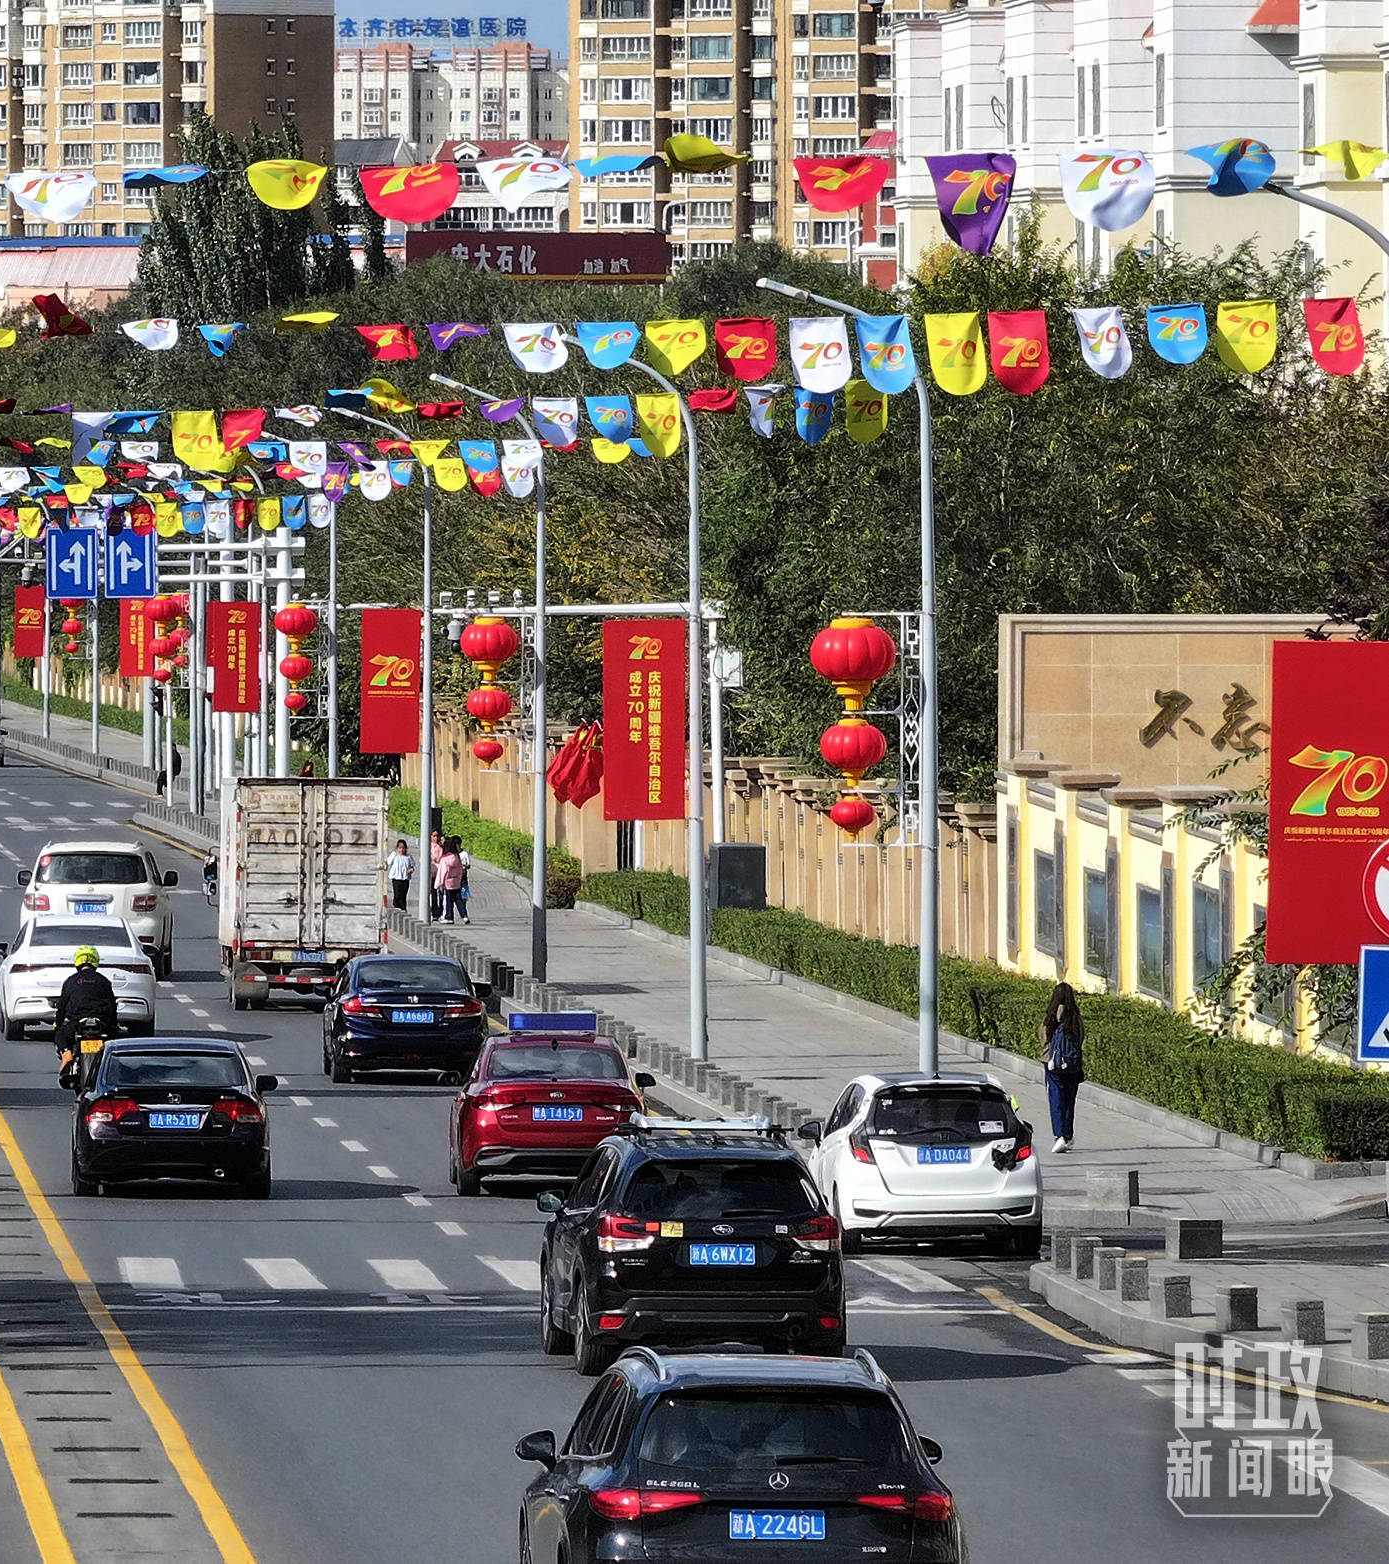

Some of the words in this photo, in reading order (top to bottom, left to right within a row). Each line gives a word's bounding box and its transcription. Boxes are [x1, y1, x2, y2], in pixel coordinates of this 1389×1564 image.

[374, 162, 442, 196] 70
[493, 161, 559, 190] 70
[1071, 154, 1141, 192] 70
[1084, 326, 1121, 354] 70
[1155, 315, 1199, 340] 70
[1227, 314, 1269, 343] 70
[1315, 321, 1356, 352] 70
[516, 334, 557, 353] 70
[657, 331, 699, 354] 70
[724, 334, 769, 358] 70
[798, 341, 843, 369] 70
[937, 338, 977, 367] 70
[999, 336, 1041, 367] 70
[864, 342, 905, 369] 70
[542, 408, 574, 424] 70
[595, 406, 627, 423] 70
[647, 411, 676, 435] 70
[802, 401, 827, 424] 70
[852, 400, 883, 423] 70
[180, 432, 212, 453] 70
[296, 450, 321, 465] 70
[365, 472, 387, 488] 70
[509, 466, 530, 481] 70
[312, 504, 329, 518] 70
[628, 635, 662, 659] 70
[369, 654, 414, 686] 70
[627, 671, 644, 743] 成立70周年
[648, 671, 662, 804] 庆祝新疆维吾尔自治区
[1288, 744, 1389, 816] 70
